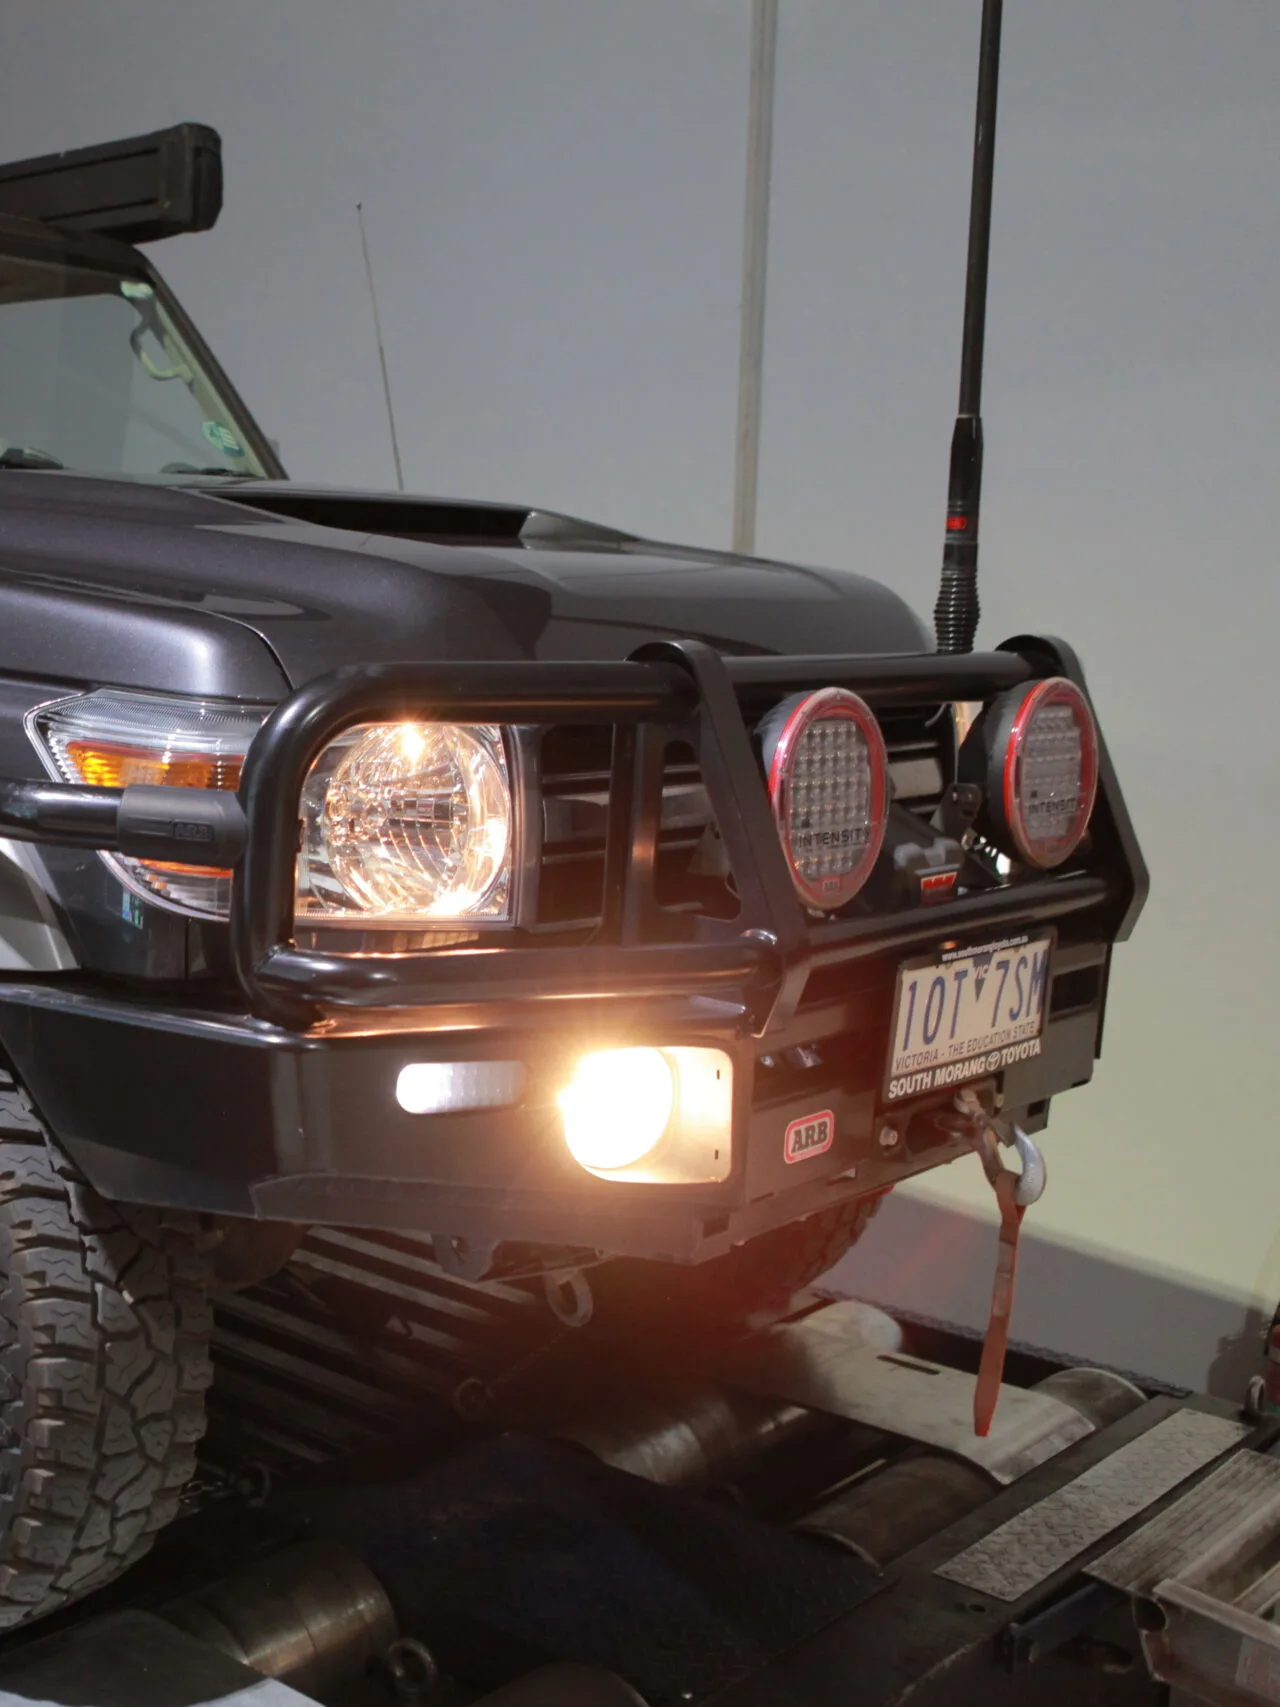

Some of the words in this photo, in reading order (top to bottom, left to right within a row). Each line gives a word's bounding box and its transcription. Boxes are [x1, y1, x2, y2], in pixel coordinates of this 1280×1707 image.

[888, 1073, 932, 1099] SOUTH
[934, 1057, 986, 1086] MORANG
[1000, 1039, 1041, 1067] TOYOTA
[895, 1051, 939, 1072] VICTORIA
[948, 1041, 965, 1058] THE
[967, 1028, 1012, 1053] EDUCATION
[1013, 1021, 1035, 1039] STATE
[790, 1119, 828, 1154] ARB
